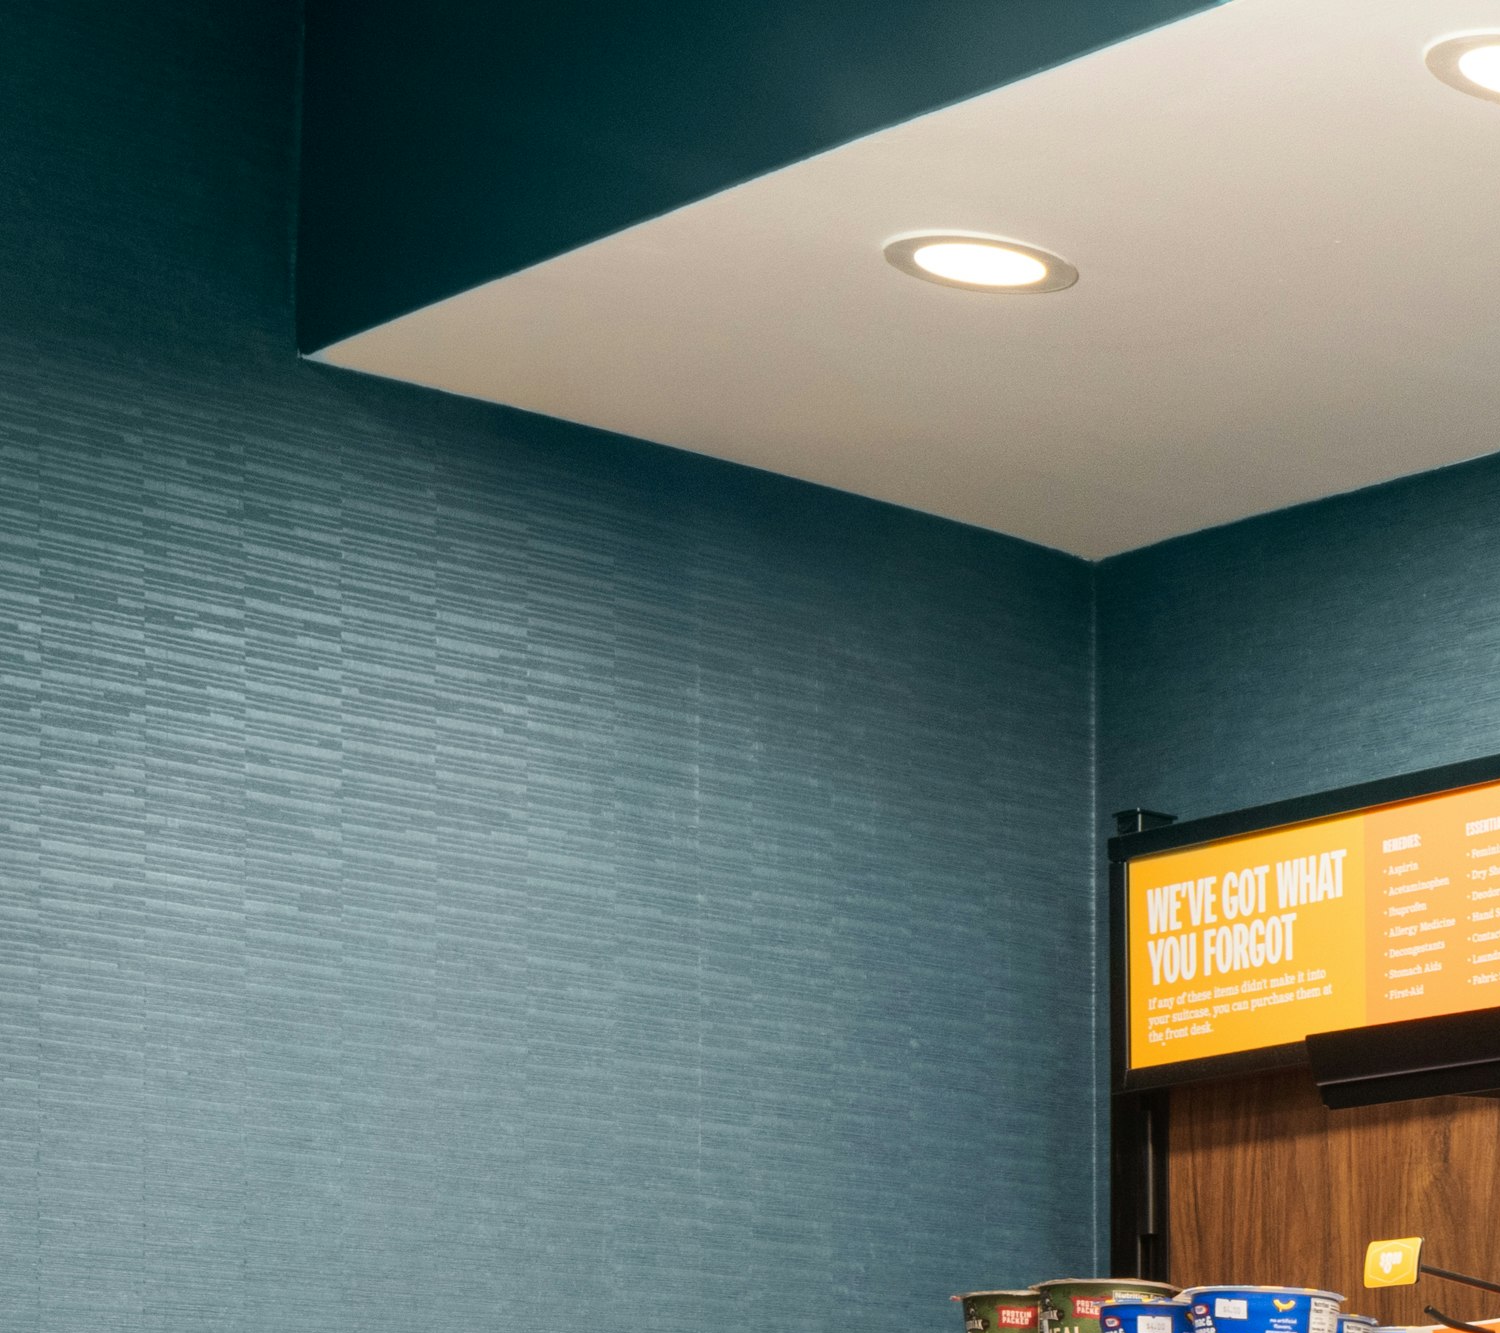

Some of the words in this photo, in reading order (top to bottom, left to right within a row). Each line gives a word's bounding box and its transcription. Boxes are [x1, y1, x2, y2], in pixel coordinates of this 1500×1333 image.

[1147, 876, 1217, 934] WE'VE
[1222, 865, 1269, 920] GOT
[1276, 849, 1347, 909] WHAT
[1147, 933, 1196, 985] YOU
[1204, 913, 1297, 976] FORGOT
[1149, 998, 1157, 1010] If
[1158, 995, 1174, 1009] any
[1177, 992, 1187, 1005] of
[1187, 988, 1211, 1003] these
[1214, 984, 1238, 998] items
[1241, 979, 1266, 993] didn't
[1270, 973, 1295, 988] make
[1308, 969, 1326, 982] into
[1149, 1015, 1169, 1029] your
[1172, 1007, 1211, 1023] suitcase,
[1213, 1003, 1229, 1018] you
[1232, 999, 1248, 1011] can
[1250, 990, 1294, 1012] purchase
[1296, 986, 1321, 1000] them
[1323, 984, 1332, 995] at
[1149, 1029, 1163, 1043] the
[1165, 1025, 1188, 1040] front
[1190, 1021, 1214, 1035] desk.
[1002, 1310, 1032, 1318] PROTEIN
[1002, 1317, 1029, 1325] PACKED
